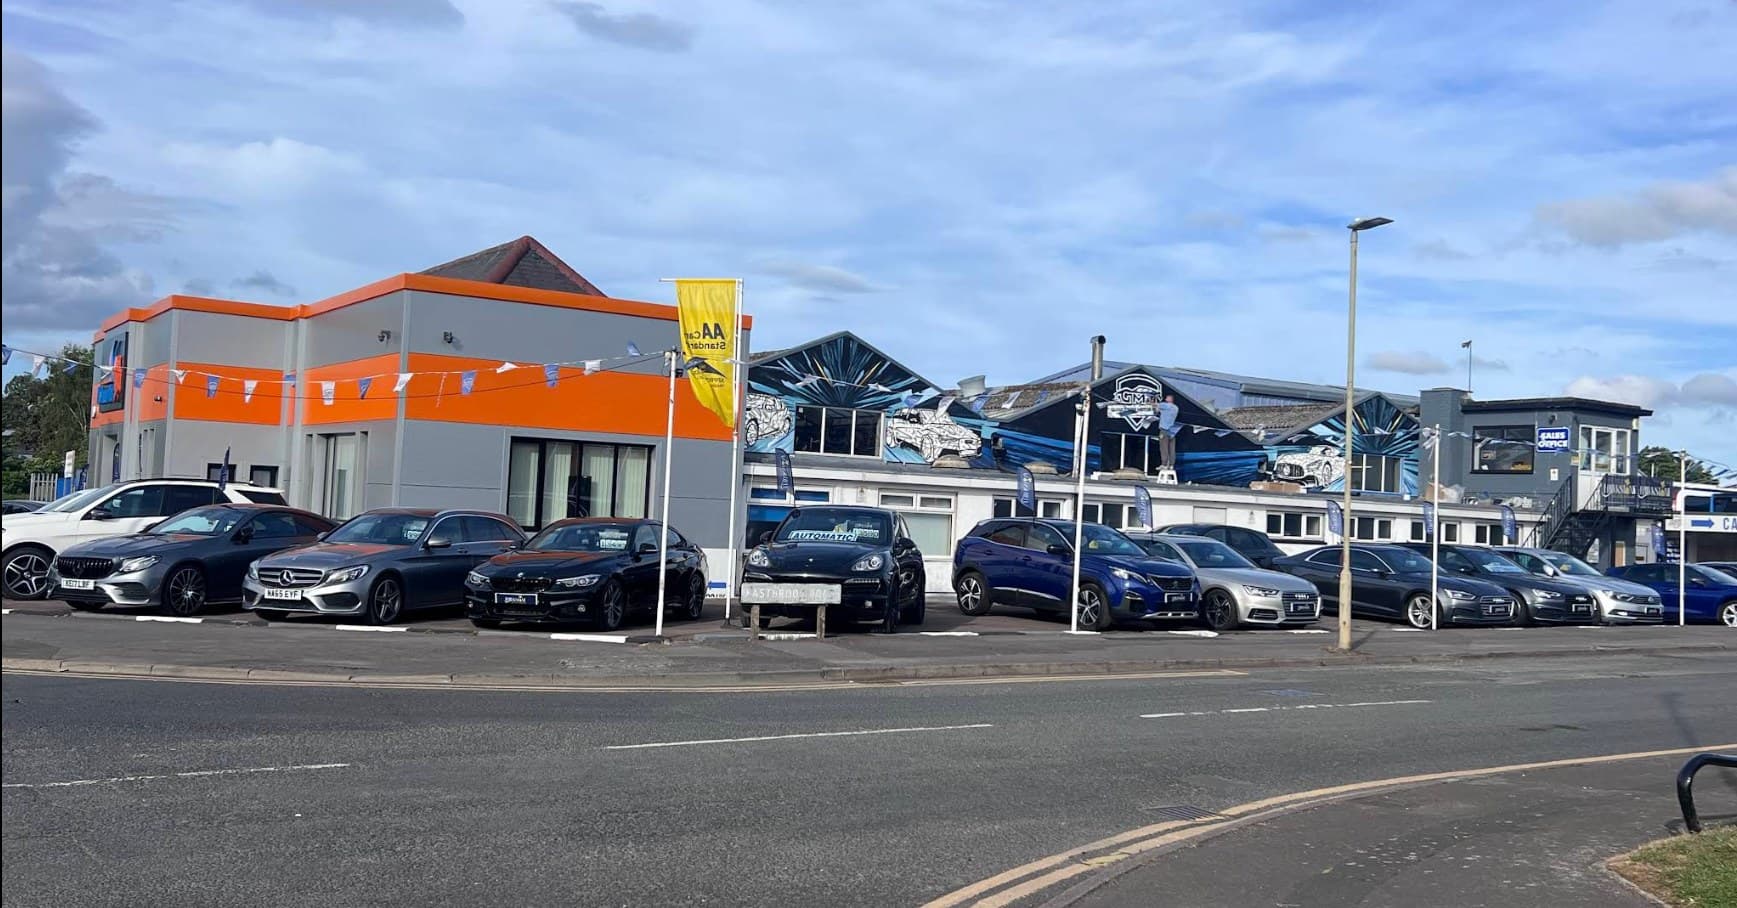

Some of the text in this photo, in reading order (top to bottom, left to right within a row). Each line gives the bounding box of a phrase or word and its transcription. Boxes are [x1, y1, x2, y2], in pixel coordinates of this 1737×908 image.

[1540, 432, 1566, 440] SALES
[1538, 440, 1568, 448] OFFICE
[793, 532, 854, 541] AUTOMATIC
